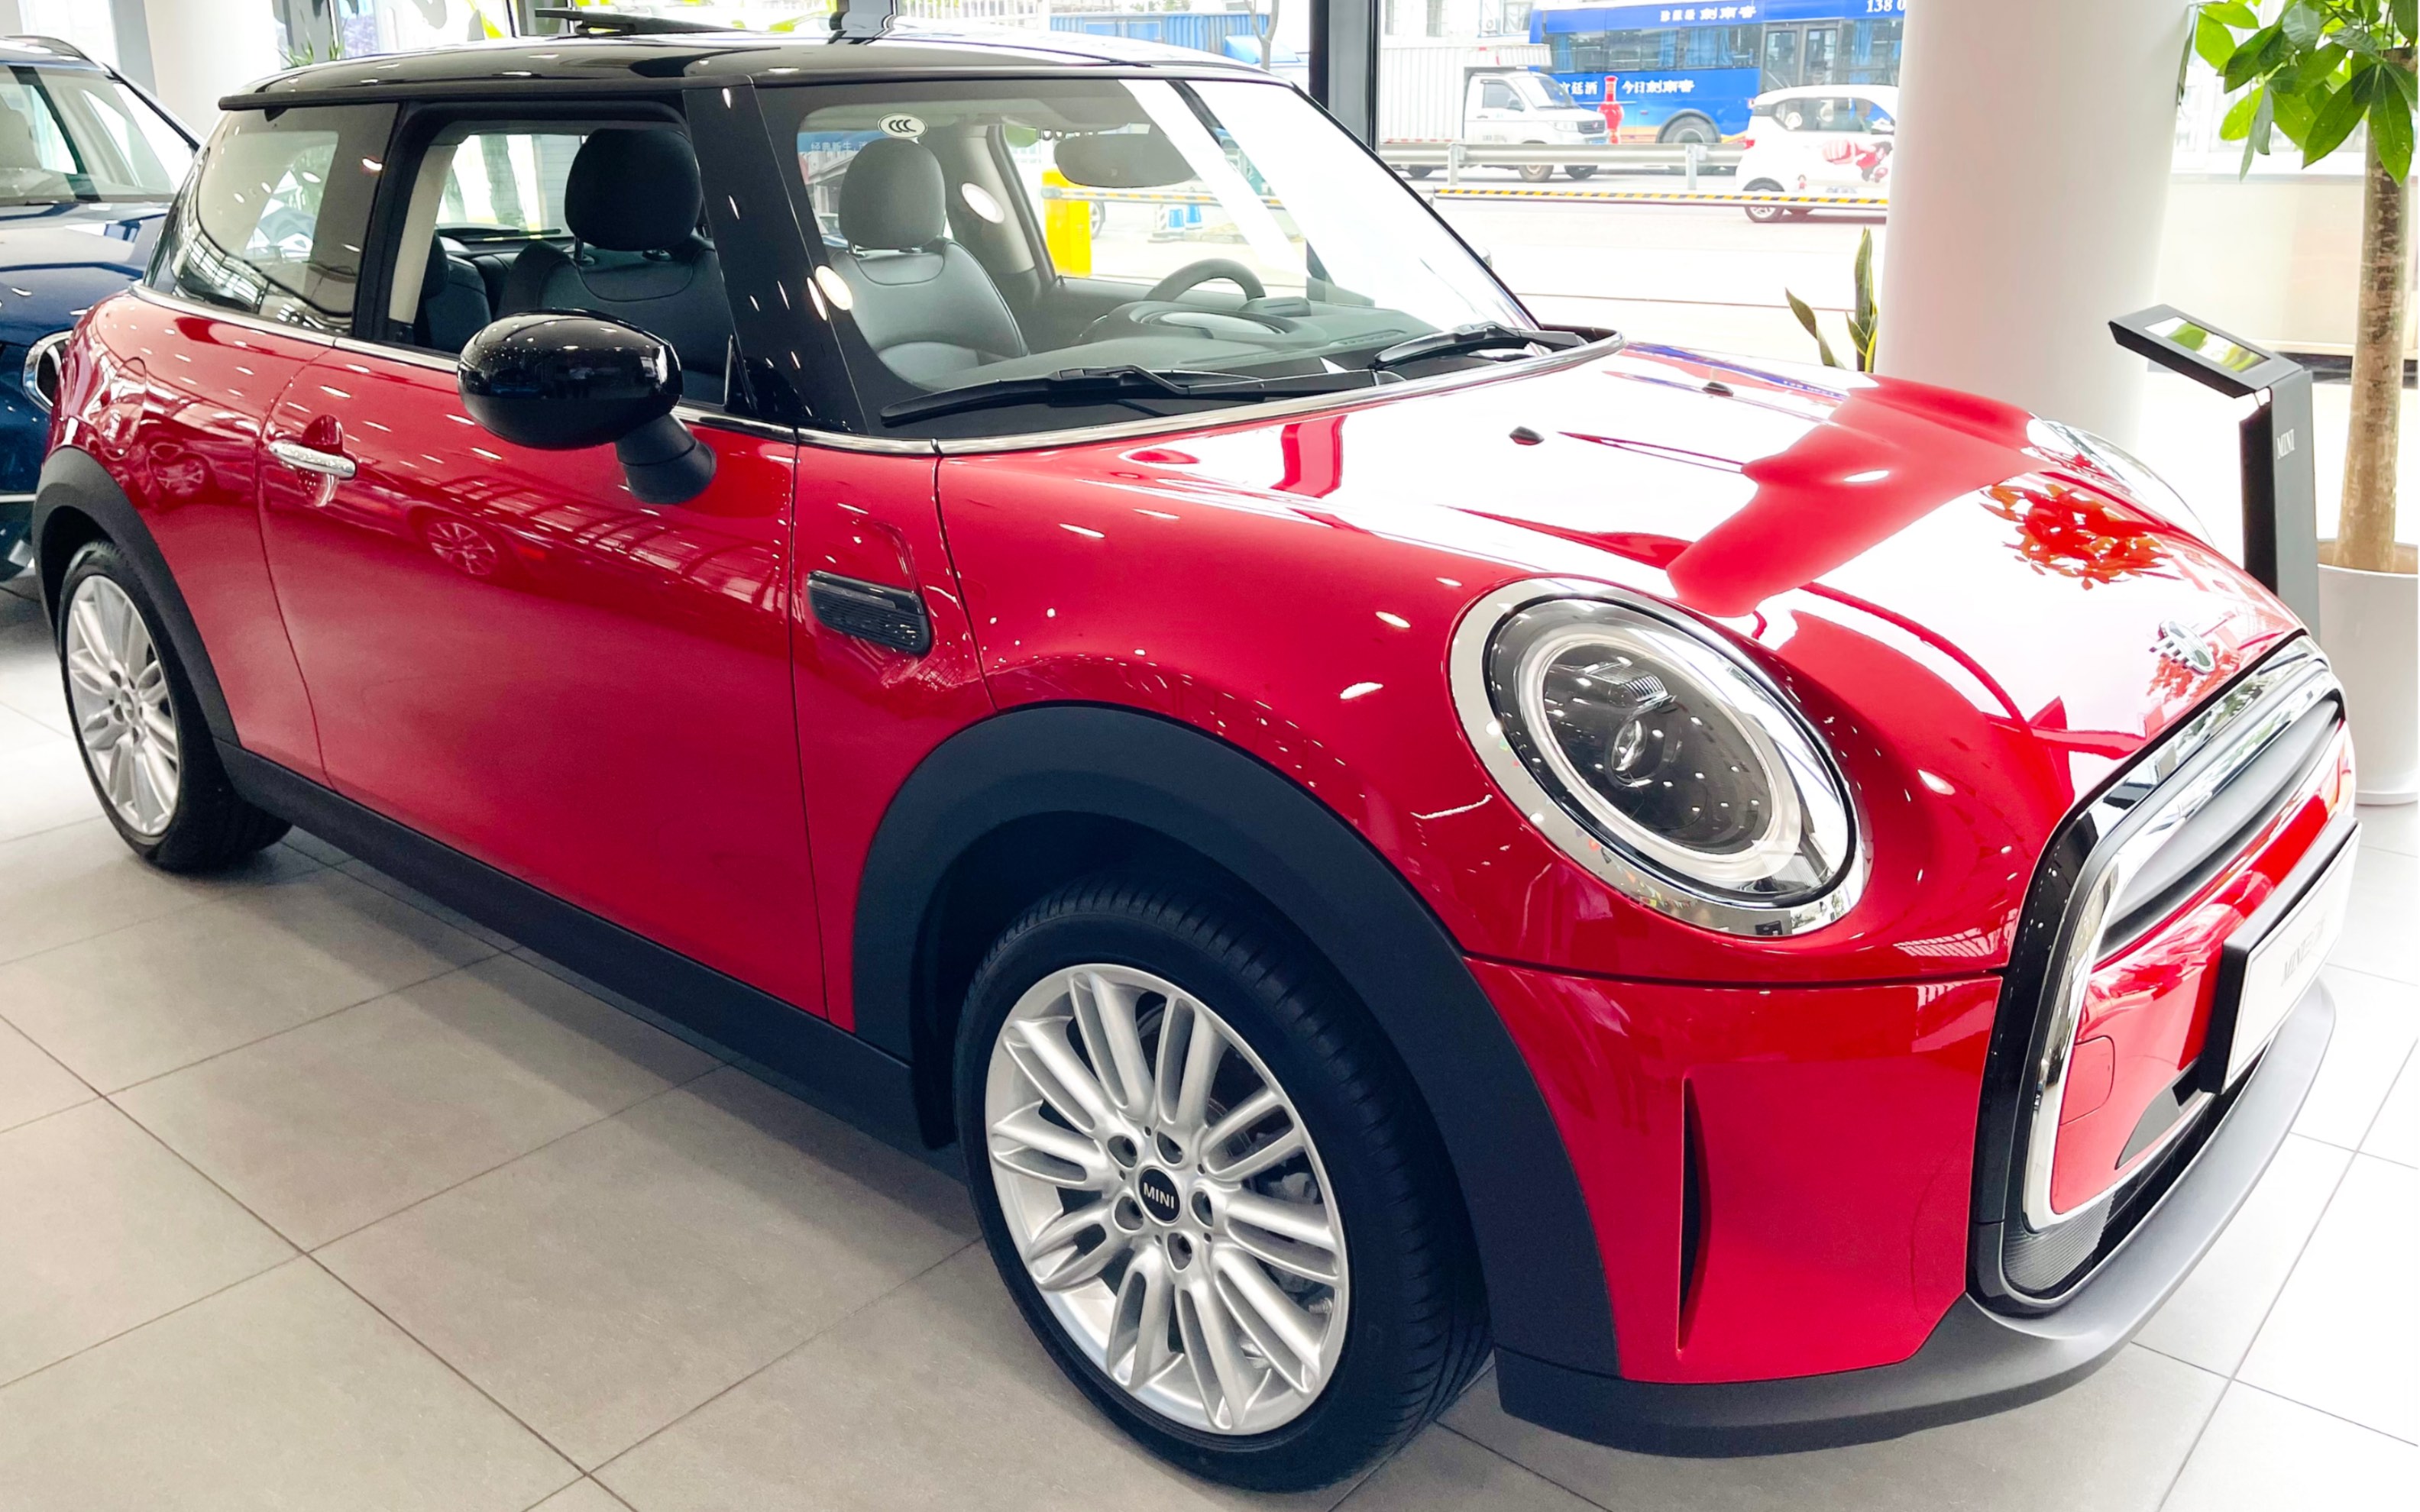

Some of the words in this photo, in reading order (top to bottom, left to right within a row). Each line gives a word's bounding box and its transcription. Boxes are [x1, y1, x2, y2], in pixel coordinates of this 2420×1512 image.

[1866, 0, 1893, 12] 138
[2276, 428, 2295, 460] MINI
[1144, 1182, 1174, 1209] MINI
